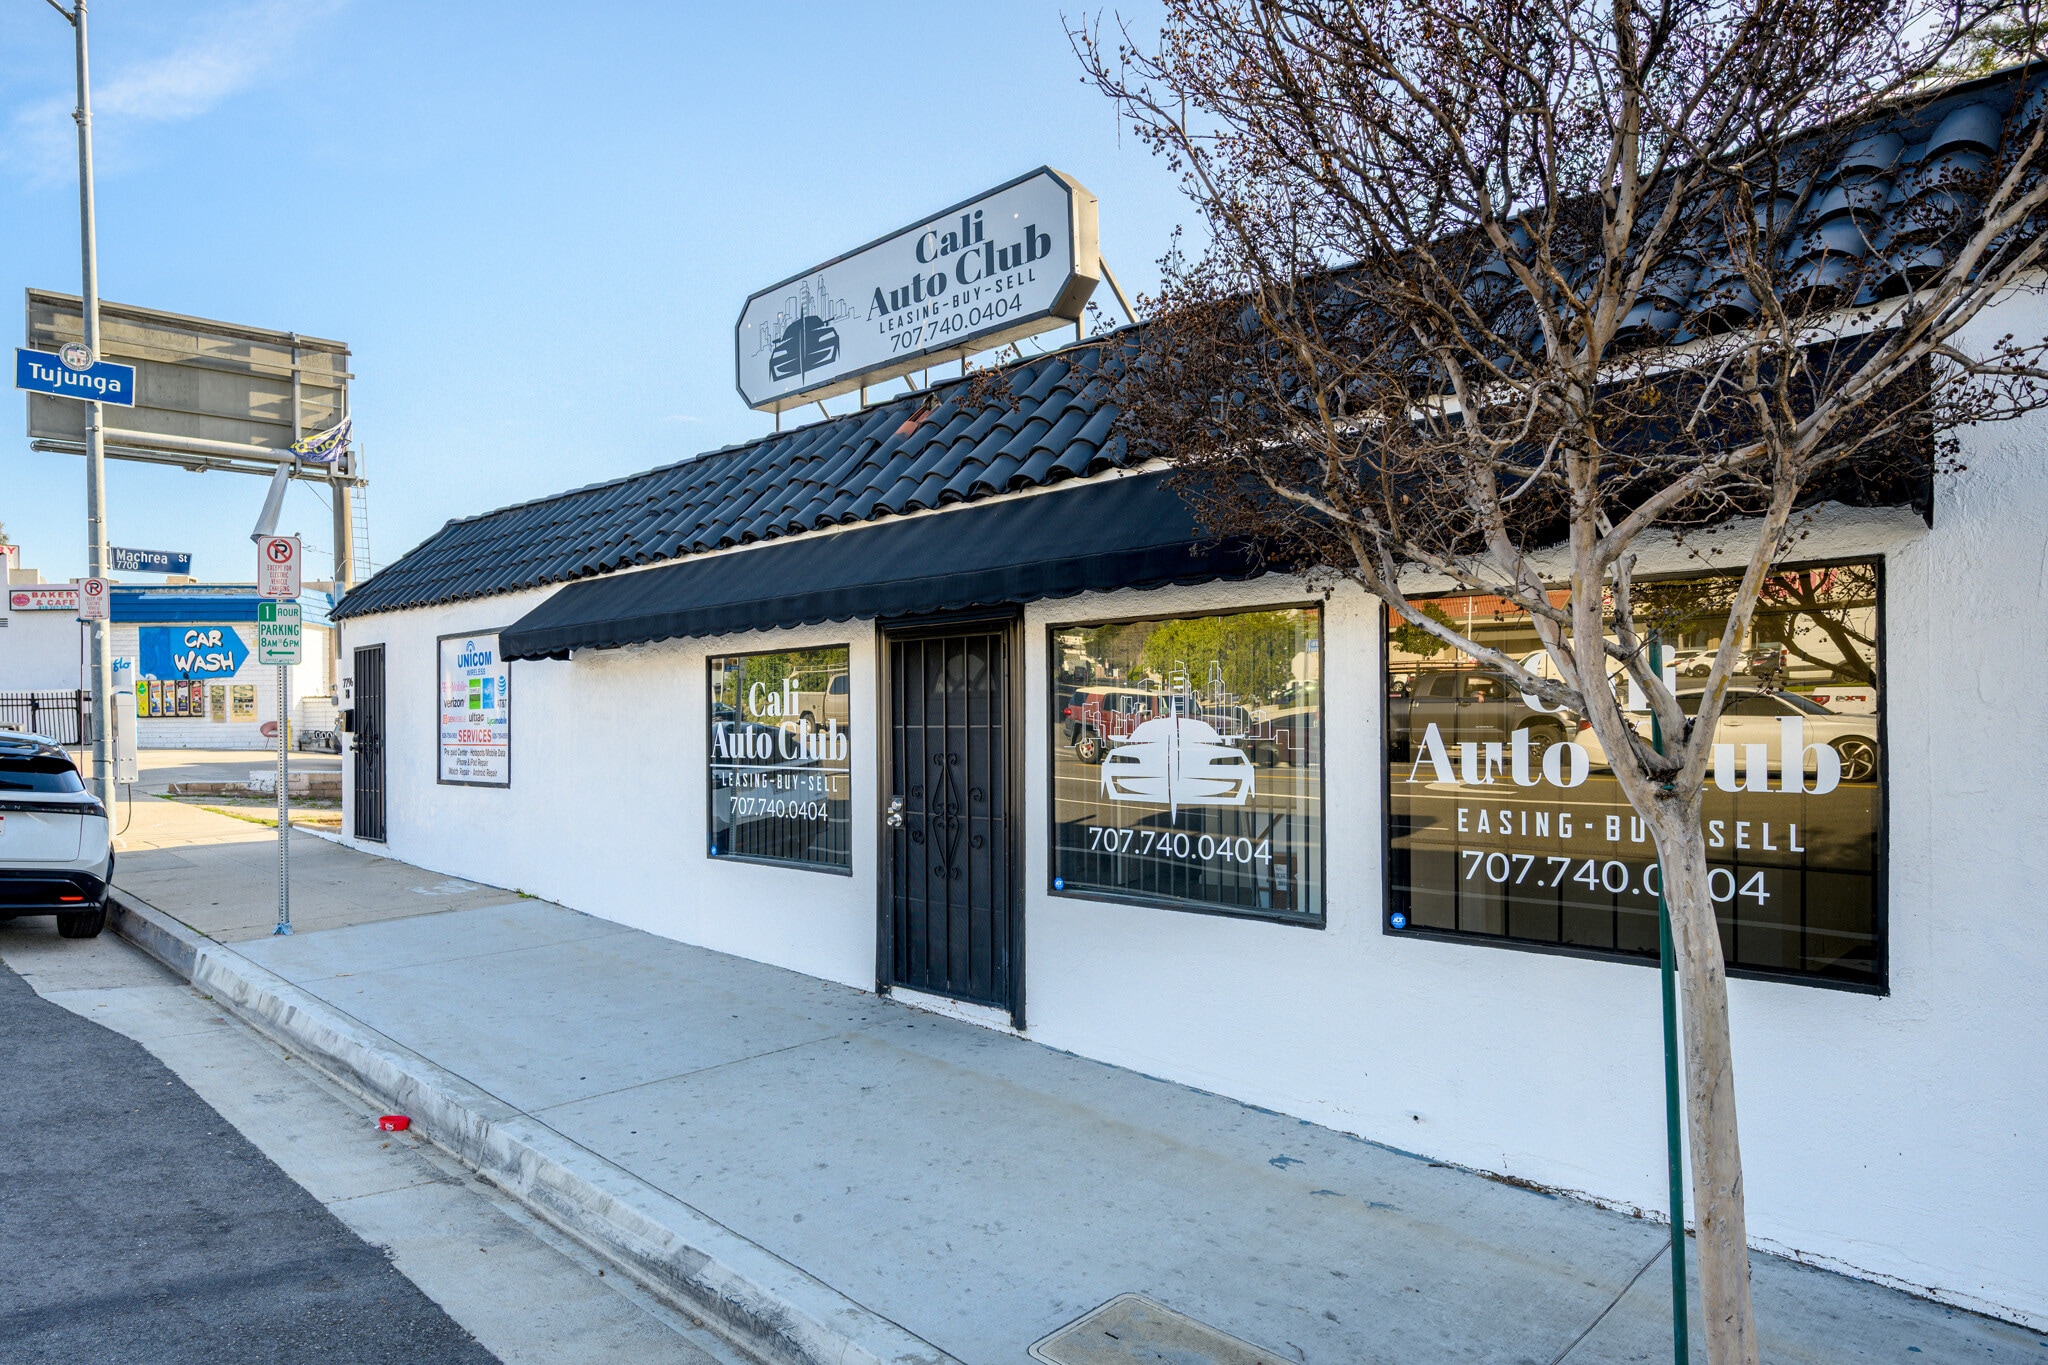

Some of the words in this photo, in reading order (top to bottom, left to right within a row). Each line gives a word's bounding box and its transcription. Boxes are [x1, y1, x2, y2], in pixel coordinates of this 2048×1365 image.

[915, 209, 985, 264] Cali
[866, 272, 948, 322] Auto
[955, 224, 1051, 285] Club
[891, 293, 1022, 353] 707.740.0404
[28, 362, 121, 394] Tujunga
[116, 549, 168, 564] Machrea
[178, 554, 188, 563] St
[117, 561, 139, 570] 7700
[265, 605, 270, 619] 1
[277, 608, 299, 617] HOUR
[184, 629, 223, 649] CAR
[261, 624, 299, 636] PARKING
[173, 651, 235, 673] WASH
[444, 697, 465, 708] verizon
[749, 678, 800, 717] Cali
[458, 729, 492, 743] SERVICES
[711, 721, 773, 760] Auto
[778, 718, 848, 761] Club
[1406, 722, 1590, 788] Auto
[1702, 716, 1841, 795] ub
[730, 797, 828, 822] 707.740.0404
[1089, 827, 1272, 866] 707.740.0404
[1462, 849, 1771, 906] 707.740.004
